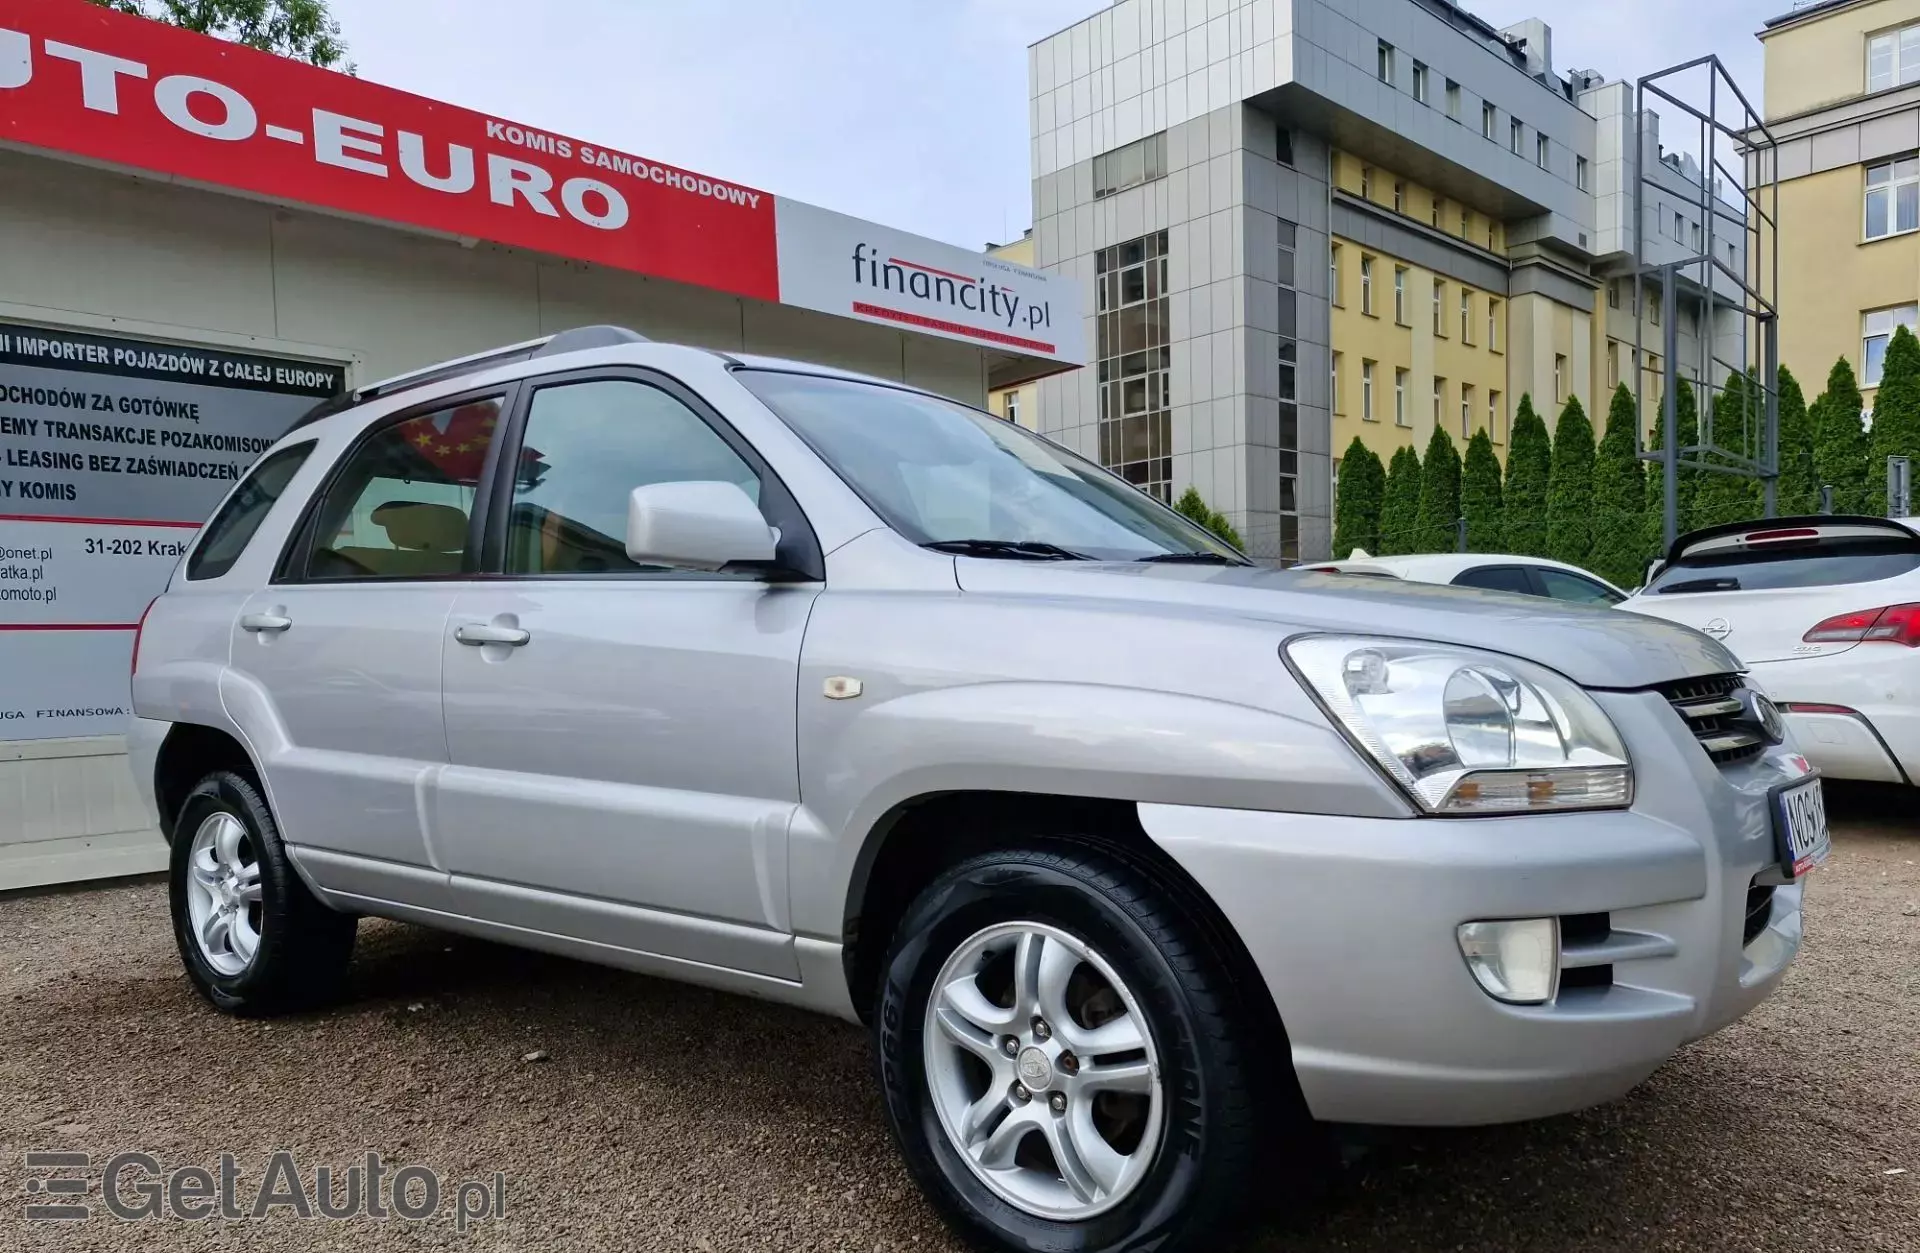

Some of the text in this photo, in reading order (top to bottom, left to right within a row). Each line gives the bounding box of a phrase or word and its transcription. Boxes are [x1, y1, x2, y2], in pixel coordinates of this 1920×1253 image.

[486, 120, 760, 209] KOMIS SAMOCHODOWY
[852, 242, 1050, 331] financity.pl
[16, 336, 110, 365] IMPORTER
[113, 347, 205, 375] POJAZDÓW
[208, 359, 220, 377] Z
[223, 361, 272, 383] CAŁEJ
[275, 367, 334, 390] EUROPY
[91, 393, 114, 412] ZA
[118, 396, 200, 425] GOTÓWKĘ
[0, 416, 39, 437] EMY
[44, 420, 156, 446] TRANSAKCJE
[7, 448, 84, 471] LEASING
[89, 454, 122, 473] BEZ
[126, 454, 239, 481] ZAŚWIADCZEŃ
[0, 480, 77, 501] Y KOMIS
[85, 538, 187, 557] 31-202 Krak
[0, 565, 43, 583] atka.pl
[0, 586, 57, 604] omoto.pl
[36, 706, 130, 719] FINANSOWA:
